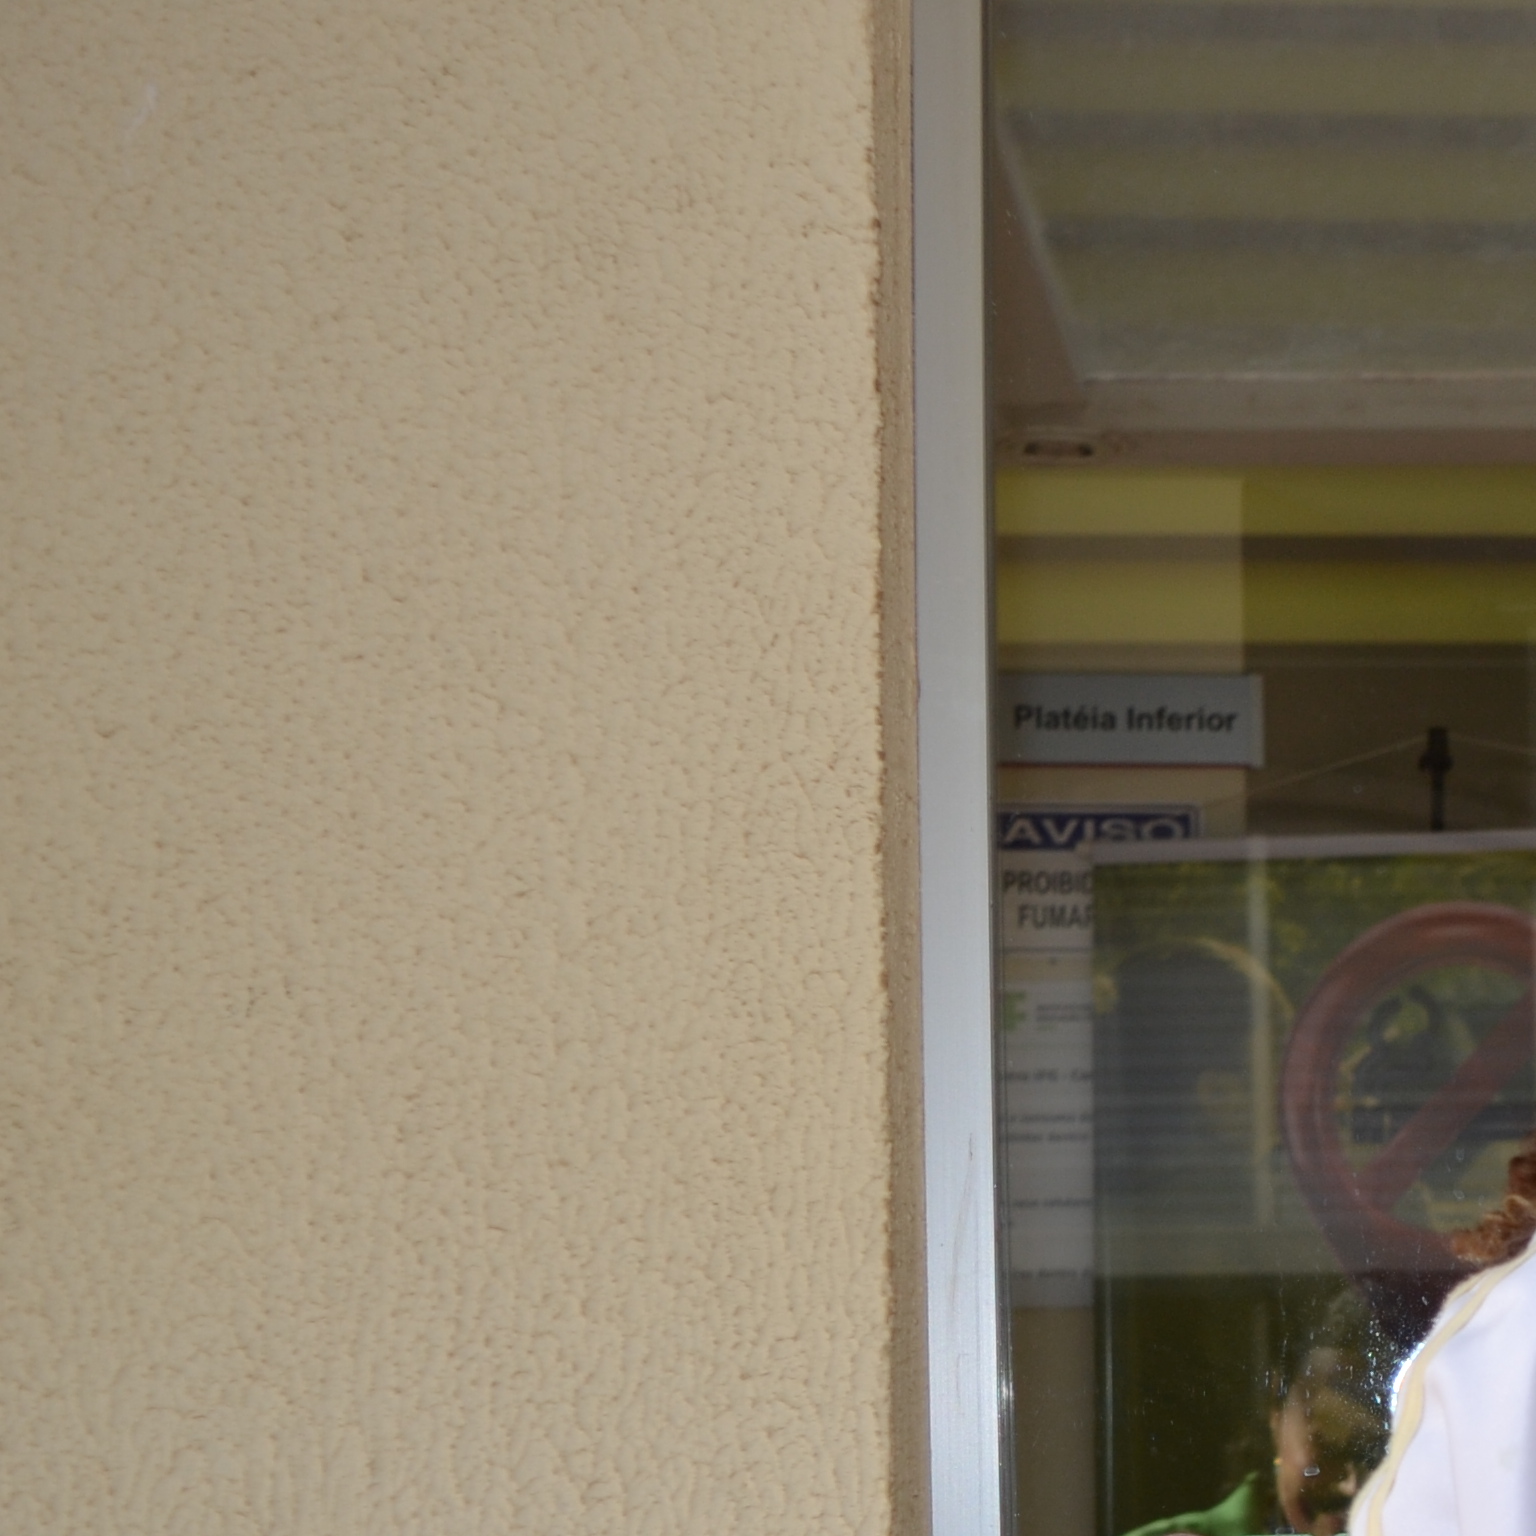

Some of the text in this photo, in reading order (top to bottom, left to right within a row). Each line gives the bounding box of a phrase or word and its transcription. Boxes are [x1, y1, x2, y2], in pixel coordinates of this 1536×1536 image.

[1014, 703, 1239, 732] Platéia Inferior
[1004, 817, 1185, 845] AVISO
